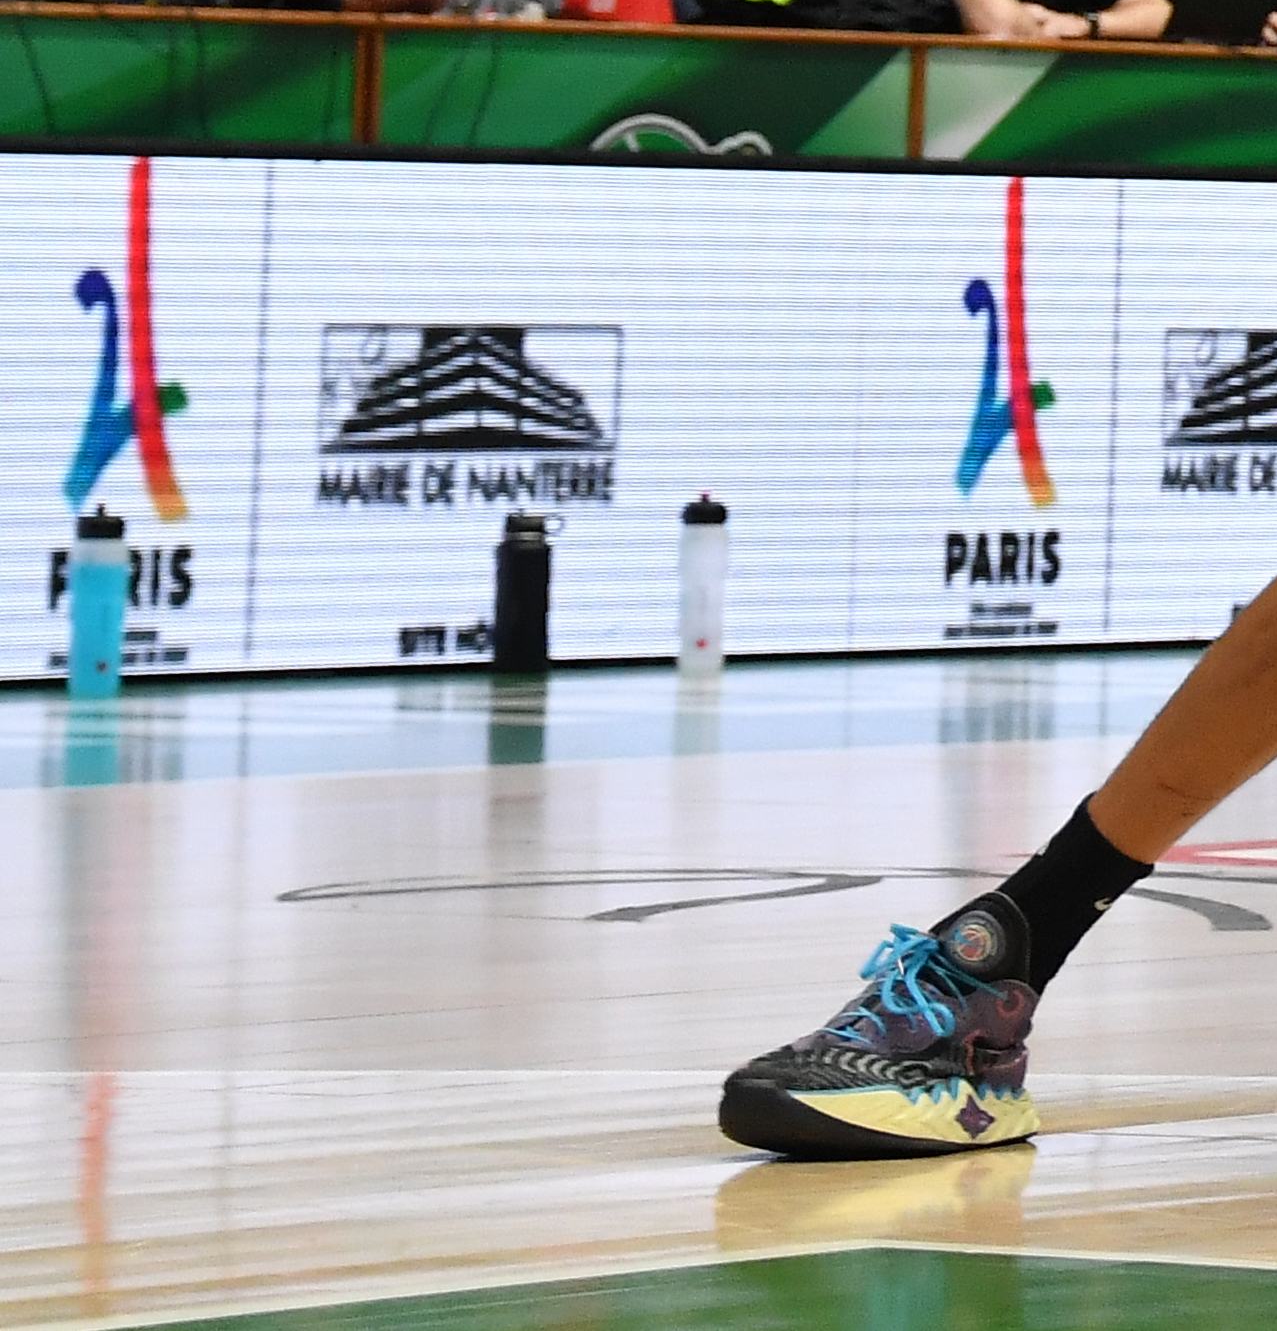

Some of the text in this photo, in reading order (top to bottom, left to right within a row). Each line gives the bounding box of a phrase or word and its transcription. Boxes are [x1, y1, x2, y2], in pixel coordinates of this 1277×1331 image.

[423, 463, 455, 504] DE
[49, 547, 194, 608] PRIS
[944, 530, 1060, 585] PARIS
